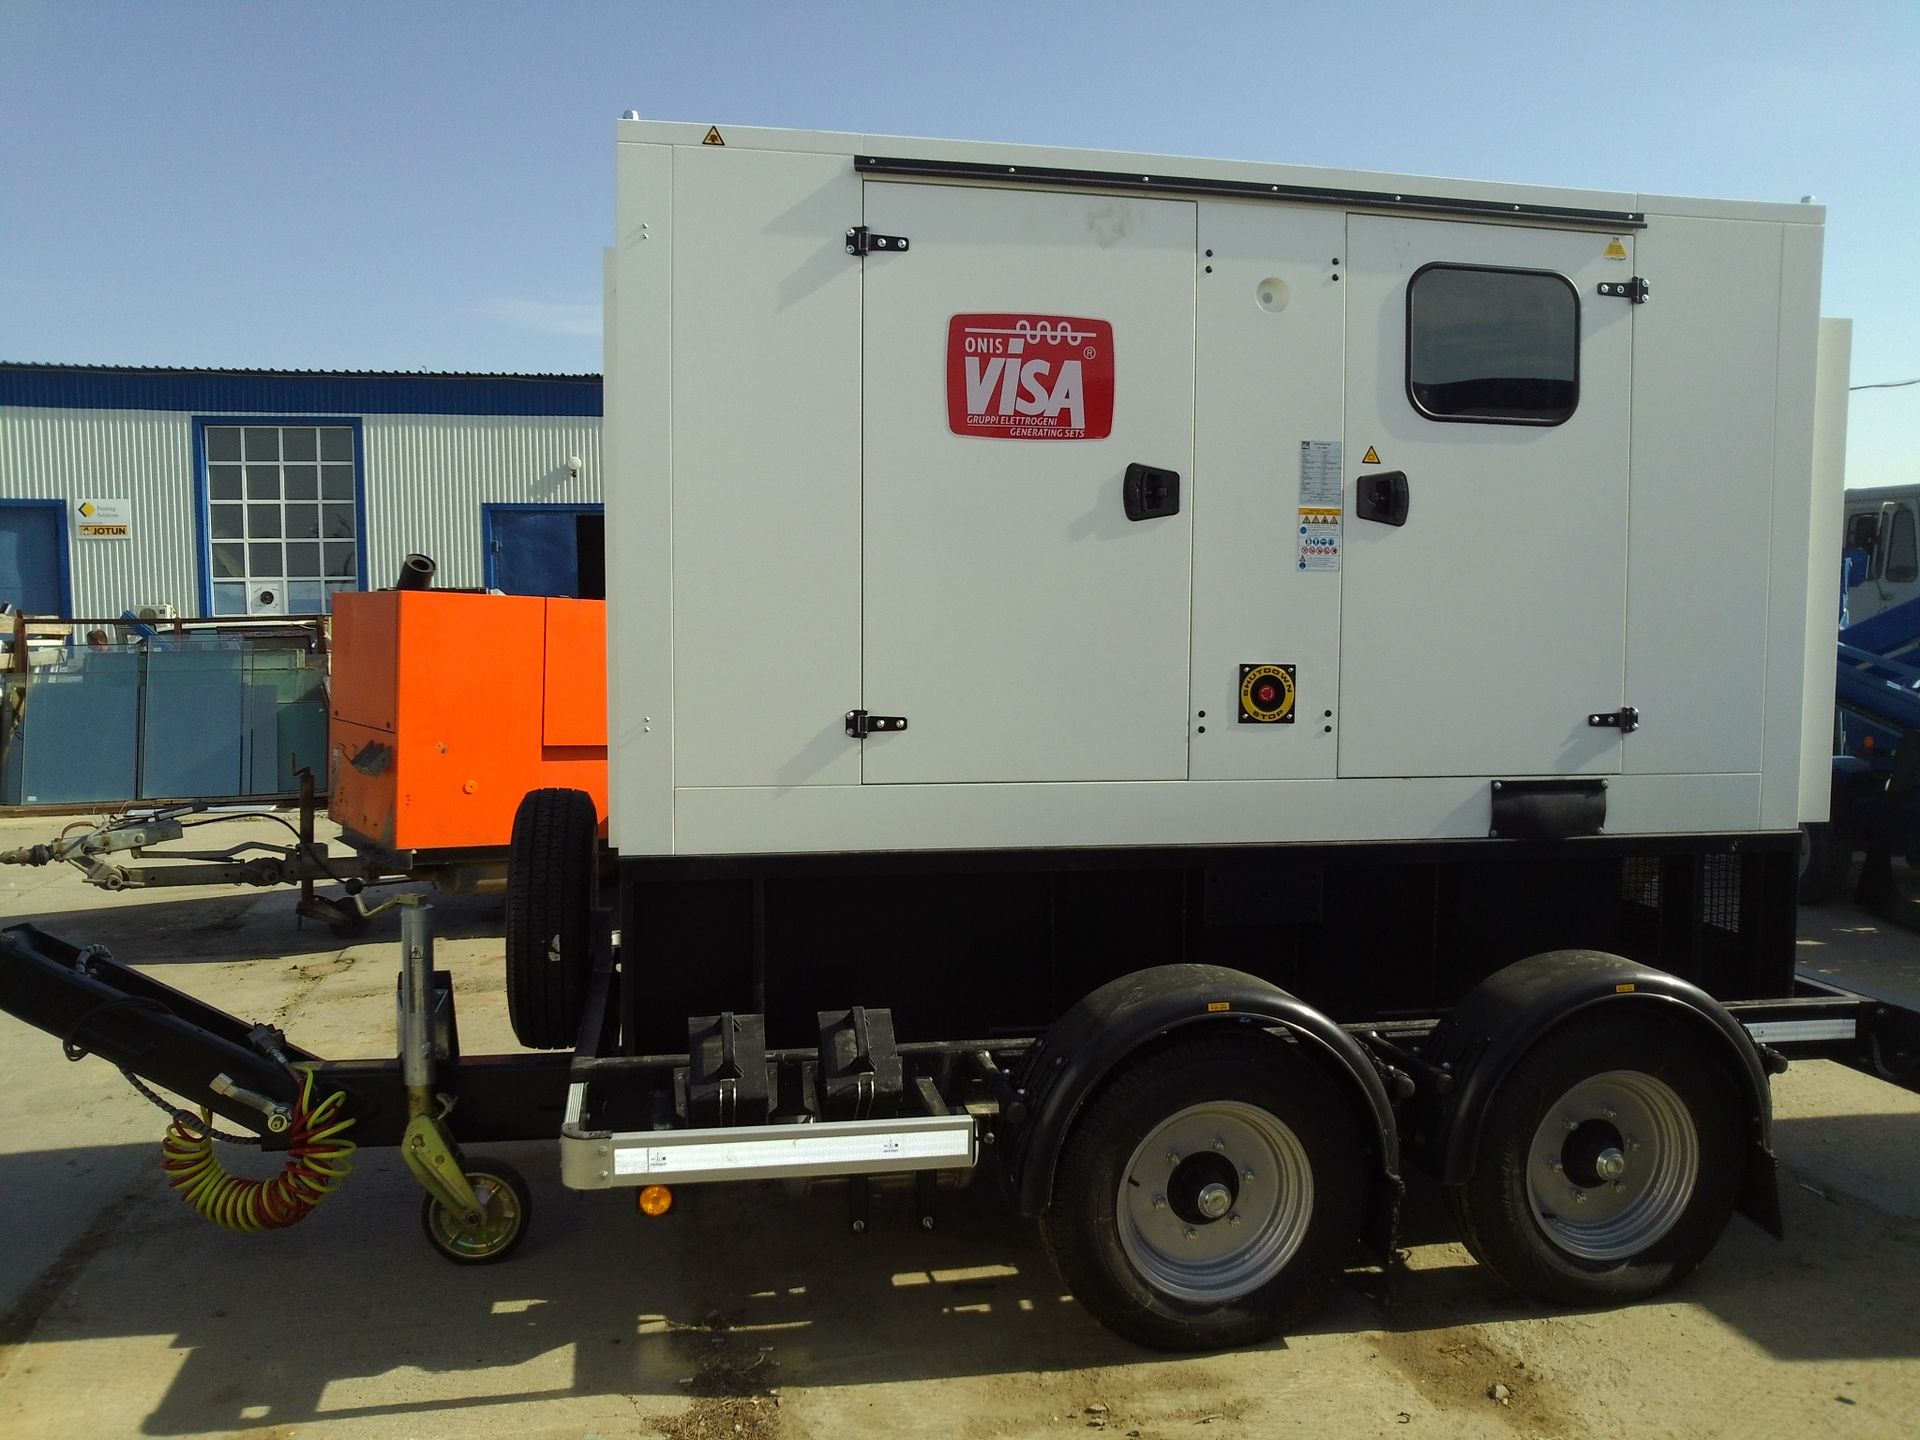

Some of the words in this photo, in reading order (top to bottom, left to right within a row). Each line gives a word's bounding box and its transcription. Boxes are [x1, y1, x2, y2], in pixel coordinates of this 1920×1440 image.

[965, 337, 1003, 354] ONIS
[966, 415, 999, 425] GRUPPI
[1001, 416, 1057, 426] ELETTROGENI
[1010, 427, 1063, 437] GENERATING
[1064, 429, 1085, 438] SETS
[93, 527, 126, 535] JOTUN
[1252, 709, 1283, 720] STOP
